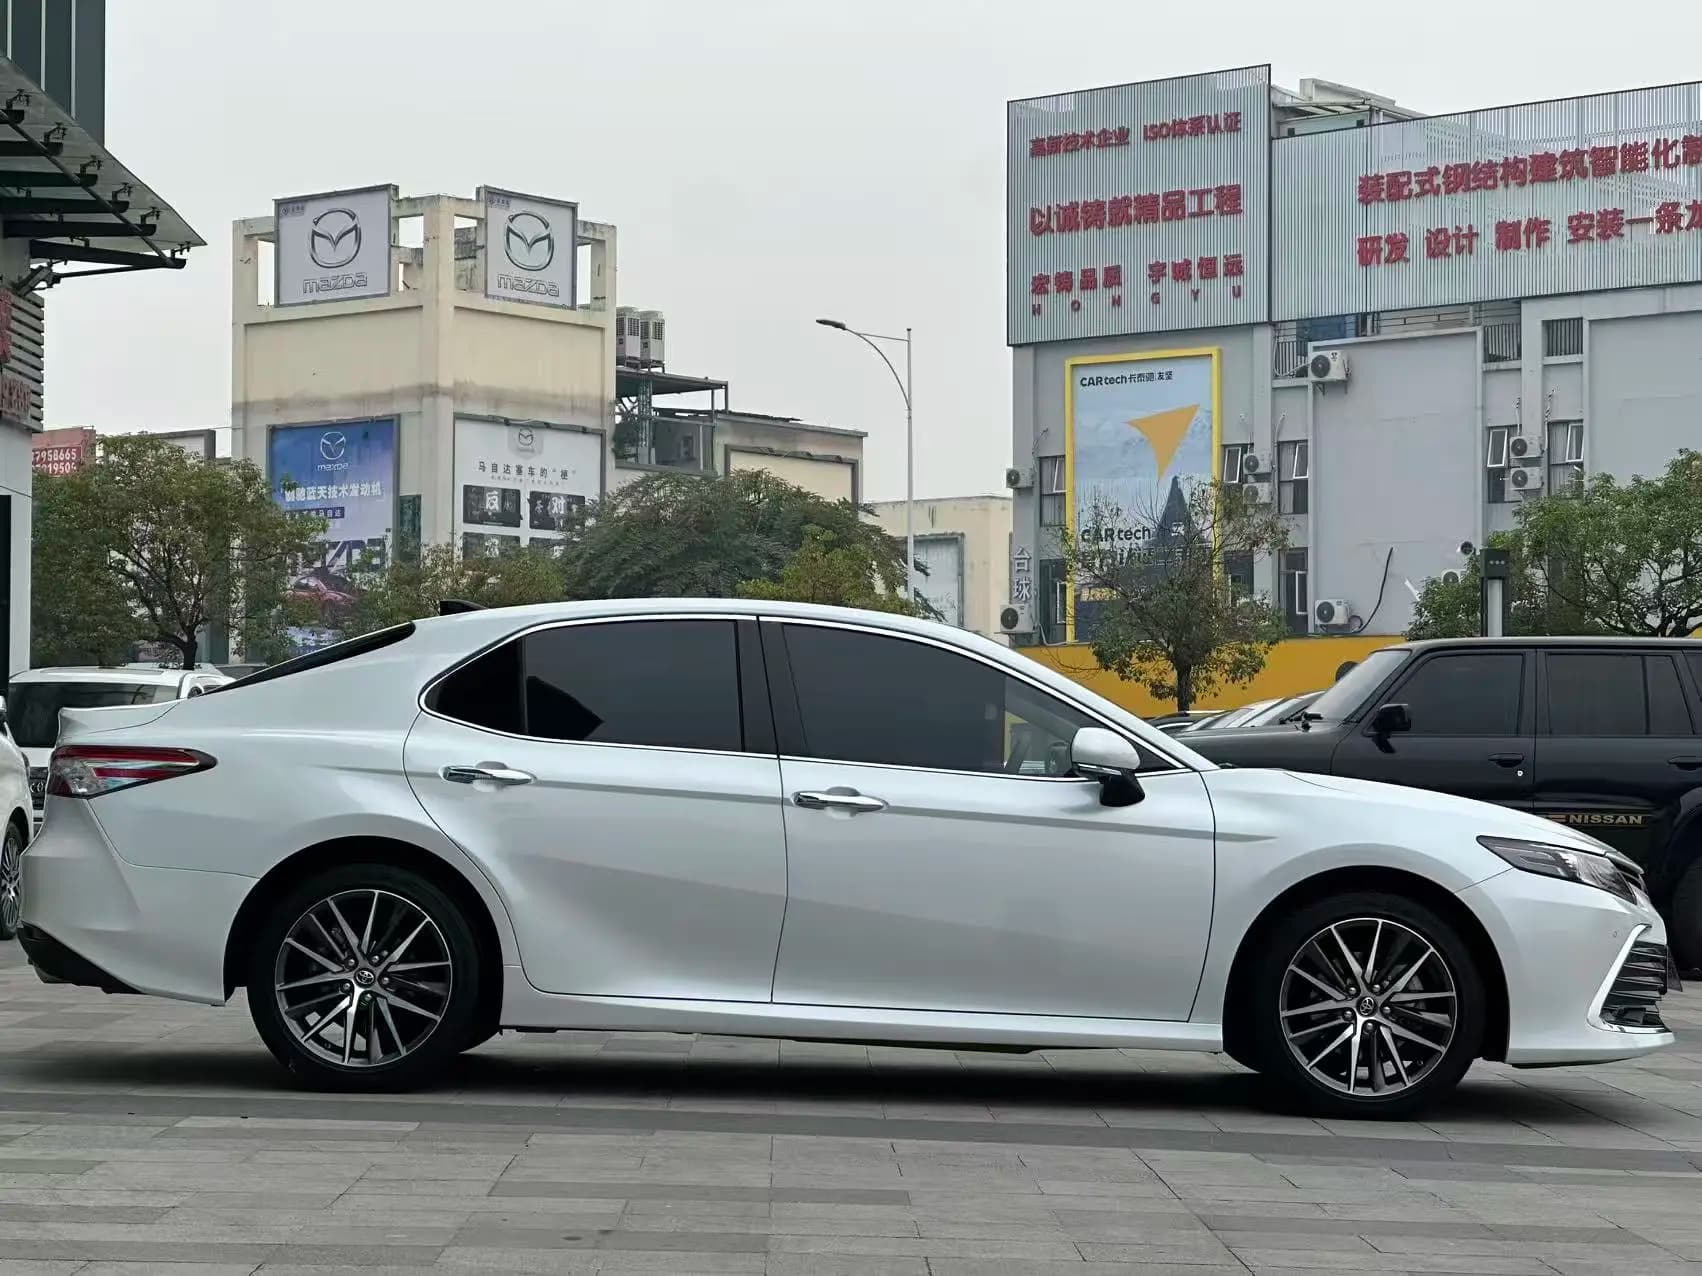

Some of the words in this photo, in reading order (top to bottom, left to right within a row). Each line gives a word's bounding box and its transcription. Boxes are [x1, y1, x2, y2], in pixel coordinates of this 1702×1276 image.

[1030, 183, 1242, 237] 以诚铸就精品工程
[1357, 233, 1410, 267] 研发
[1425, 224, 1479, 260] 设计
[1494, 217, 1551, 252] 制作
[32, 448, 77, 464] 7958665
[1569, 814, 1643, 825] NISSAN
